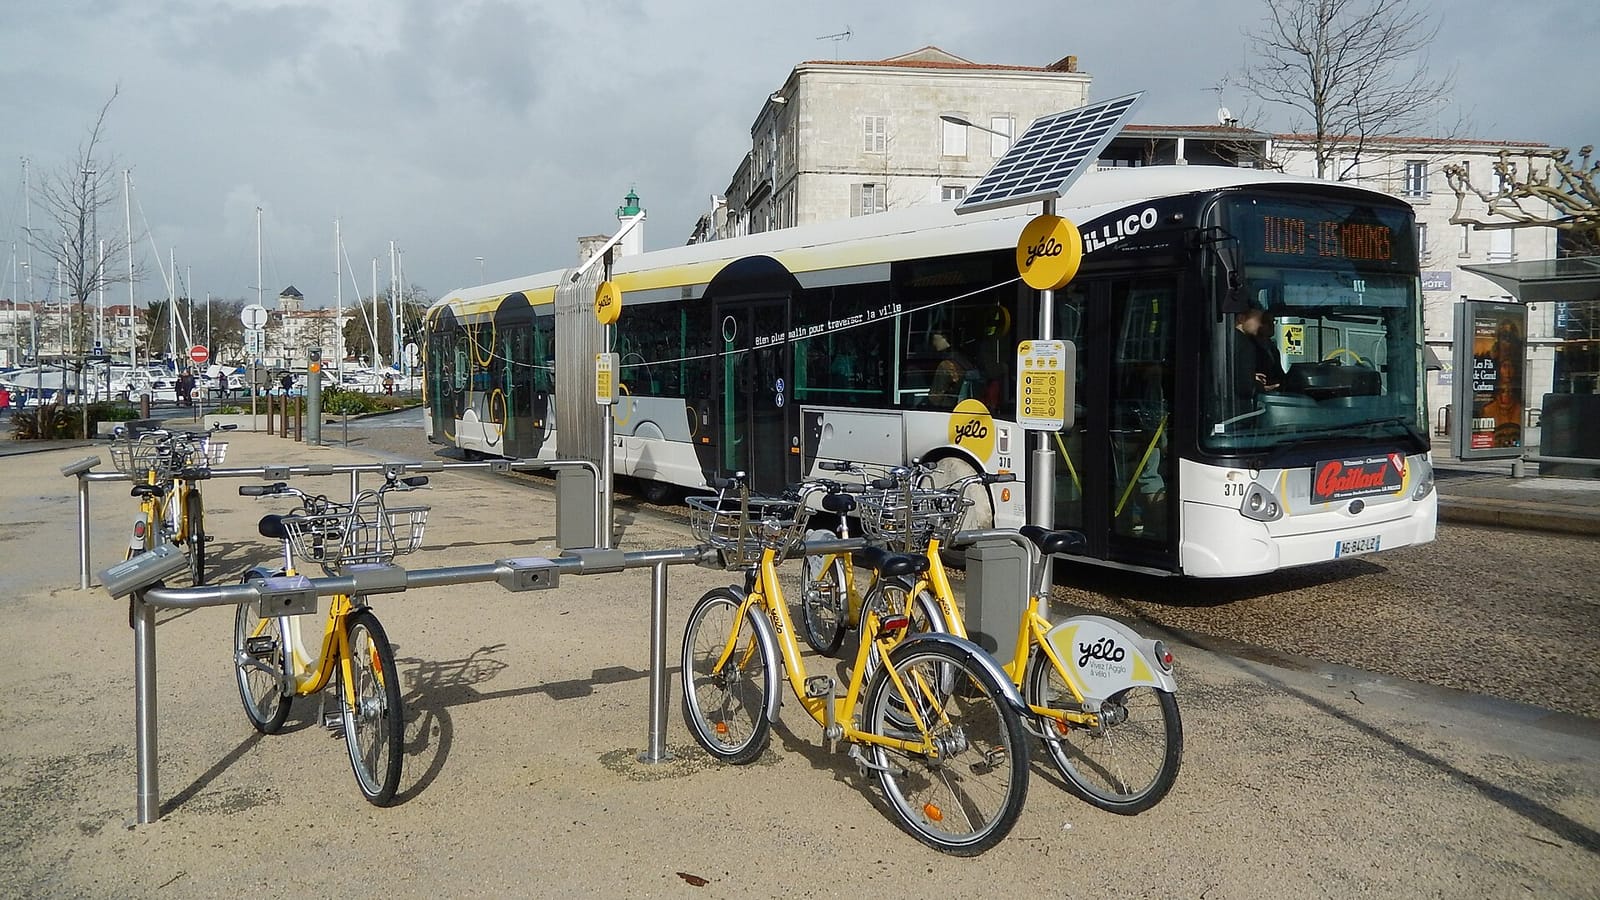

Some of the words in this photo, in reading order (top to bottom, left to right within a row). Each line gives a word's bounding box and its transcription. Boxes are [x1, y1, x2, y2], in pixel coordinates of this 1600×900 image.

[1025, 236, 1063, 267] yélo
[771, 331, 785, 344] plus
[788, 327, 806, 339] malin
[808, 323, 824, 336] pour
[866, 310, 876, 320] la
[879, 303, 902, 317] ville
[954, 419, 988, 445] yélo
[1224, 483, 1244, 497] 370
[1078, 637, 1125, 668] yélo
